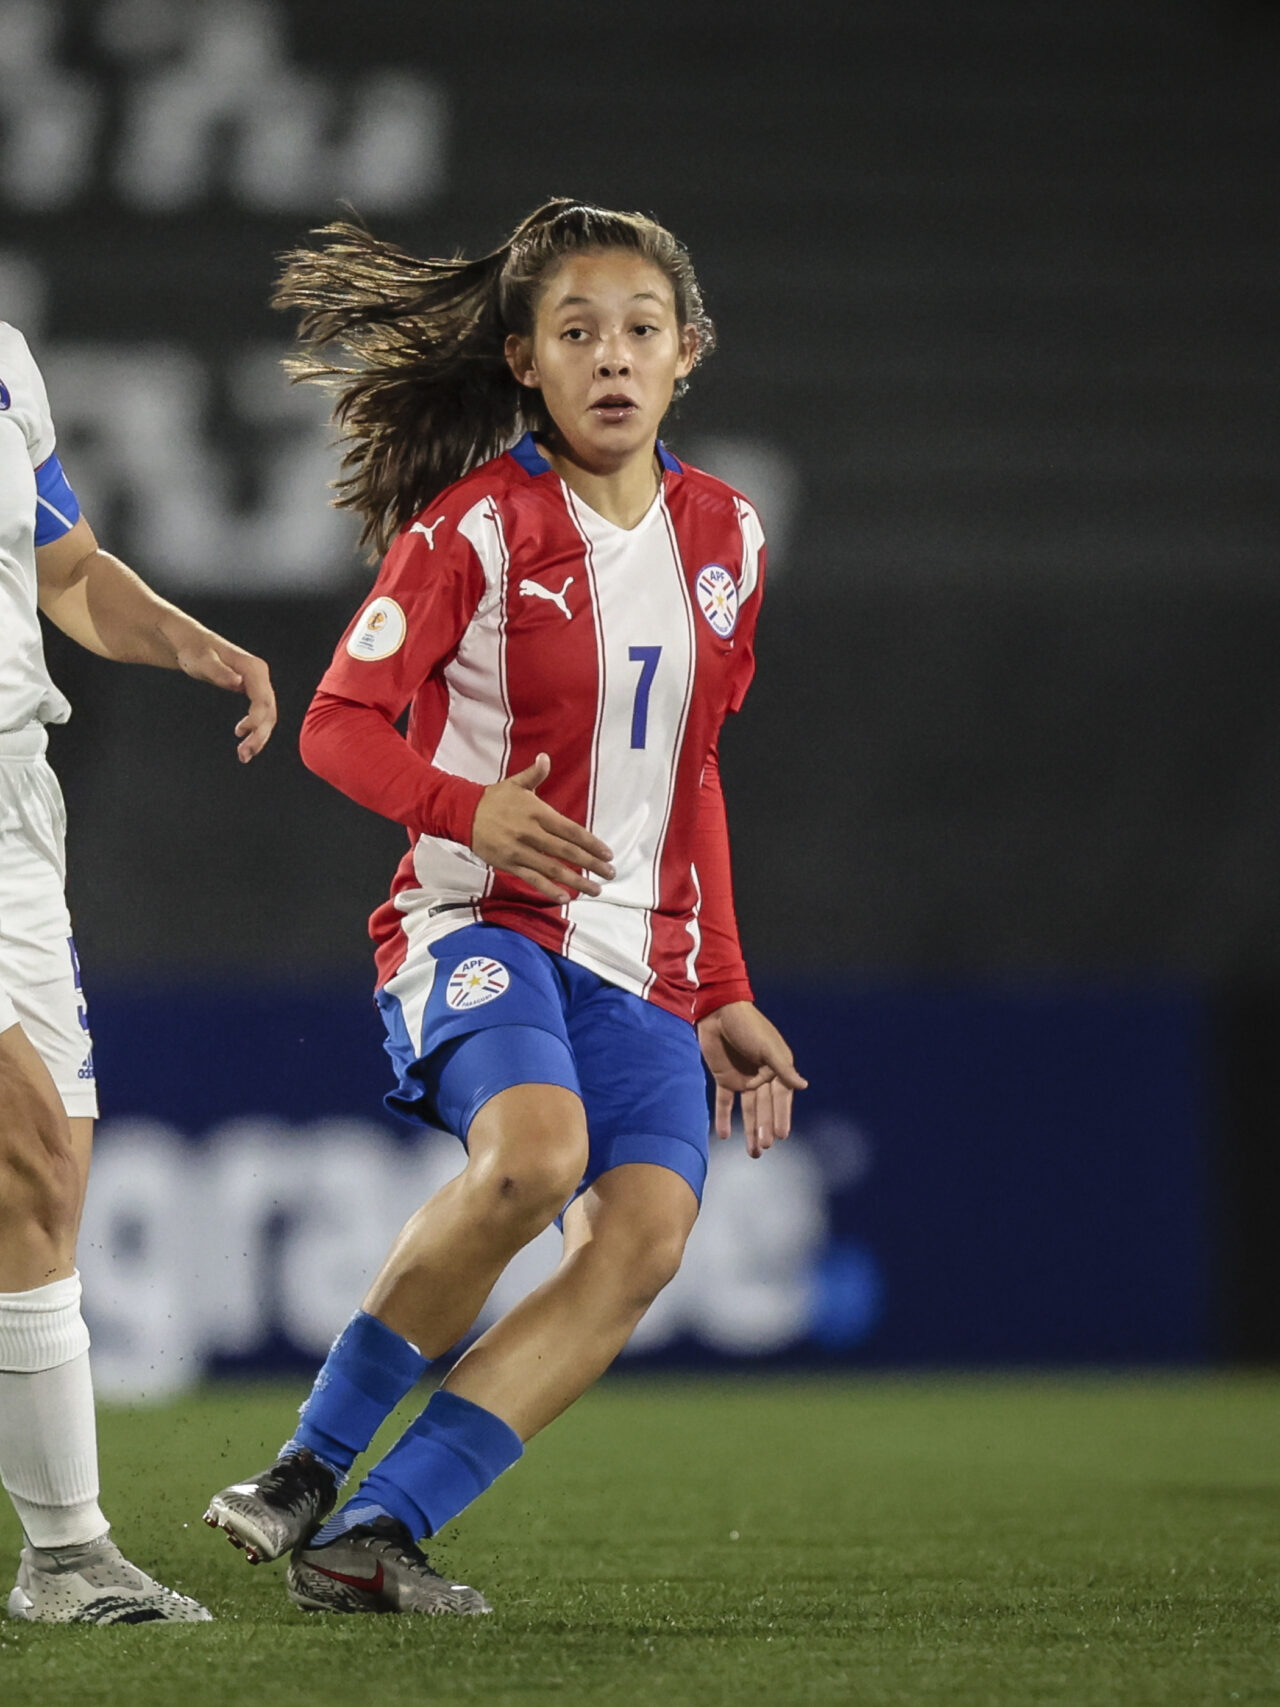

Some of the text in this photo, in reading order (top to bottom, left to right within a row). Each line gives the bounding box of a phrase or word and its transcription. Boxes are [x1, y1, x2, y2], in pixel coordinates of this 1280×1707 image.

[710, 570, 725, 582] APF
[628, 645, 663, 750] 7
[462, 959, 485, 972] APF
